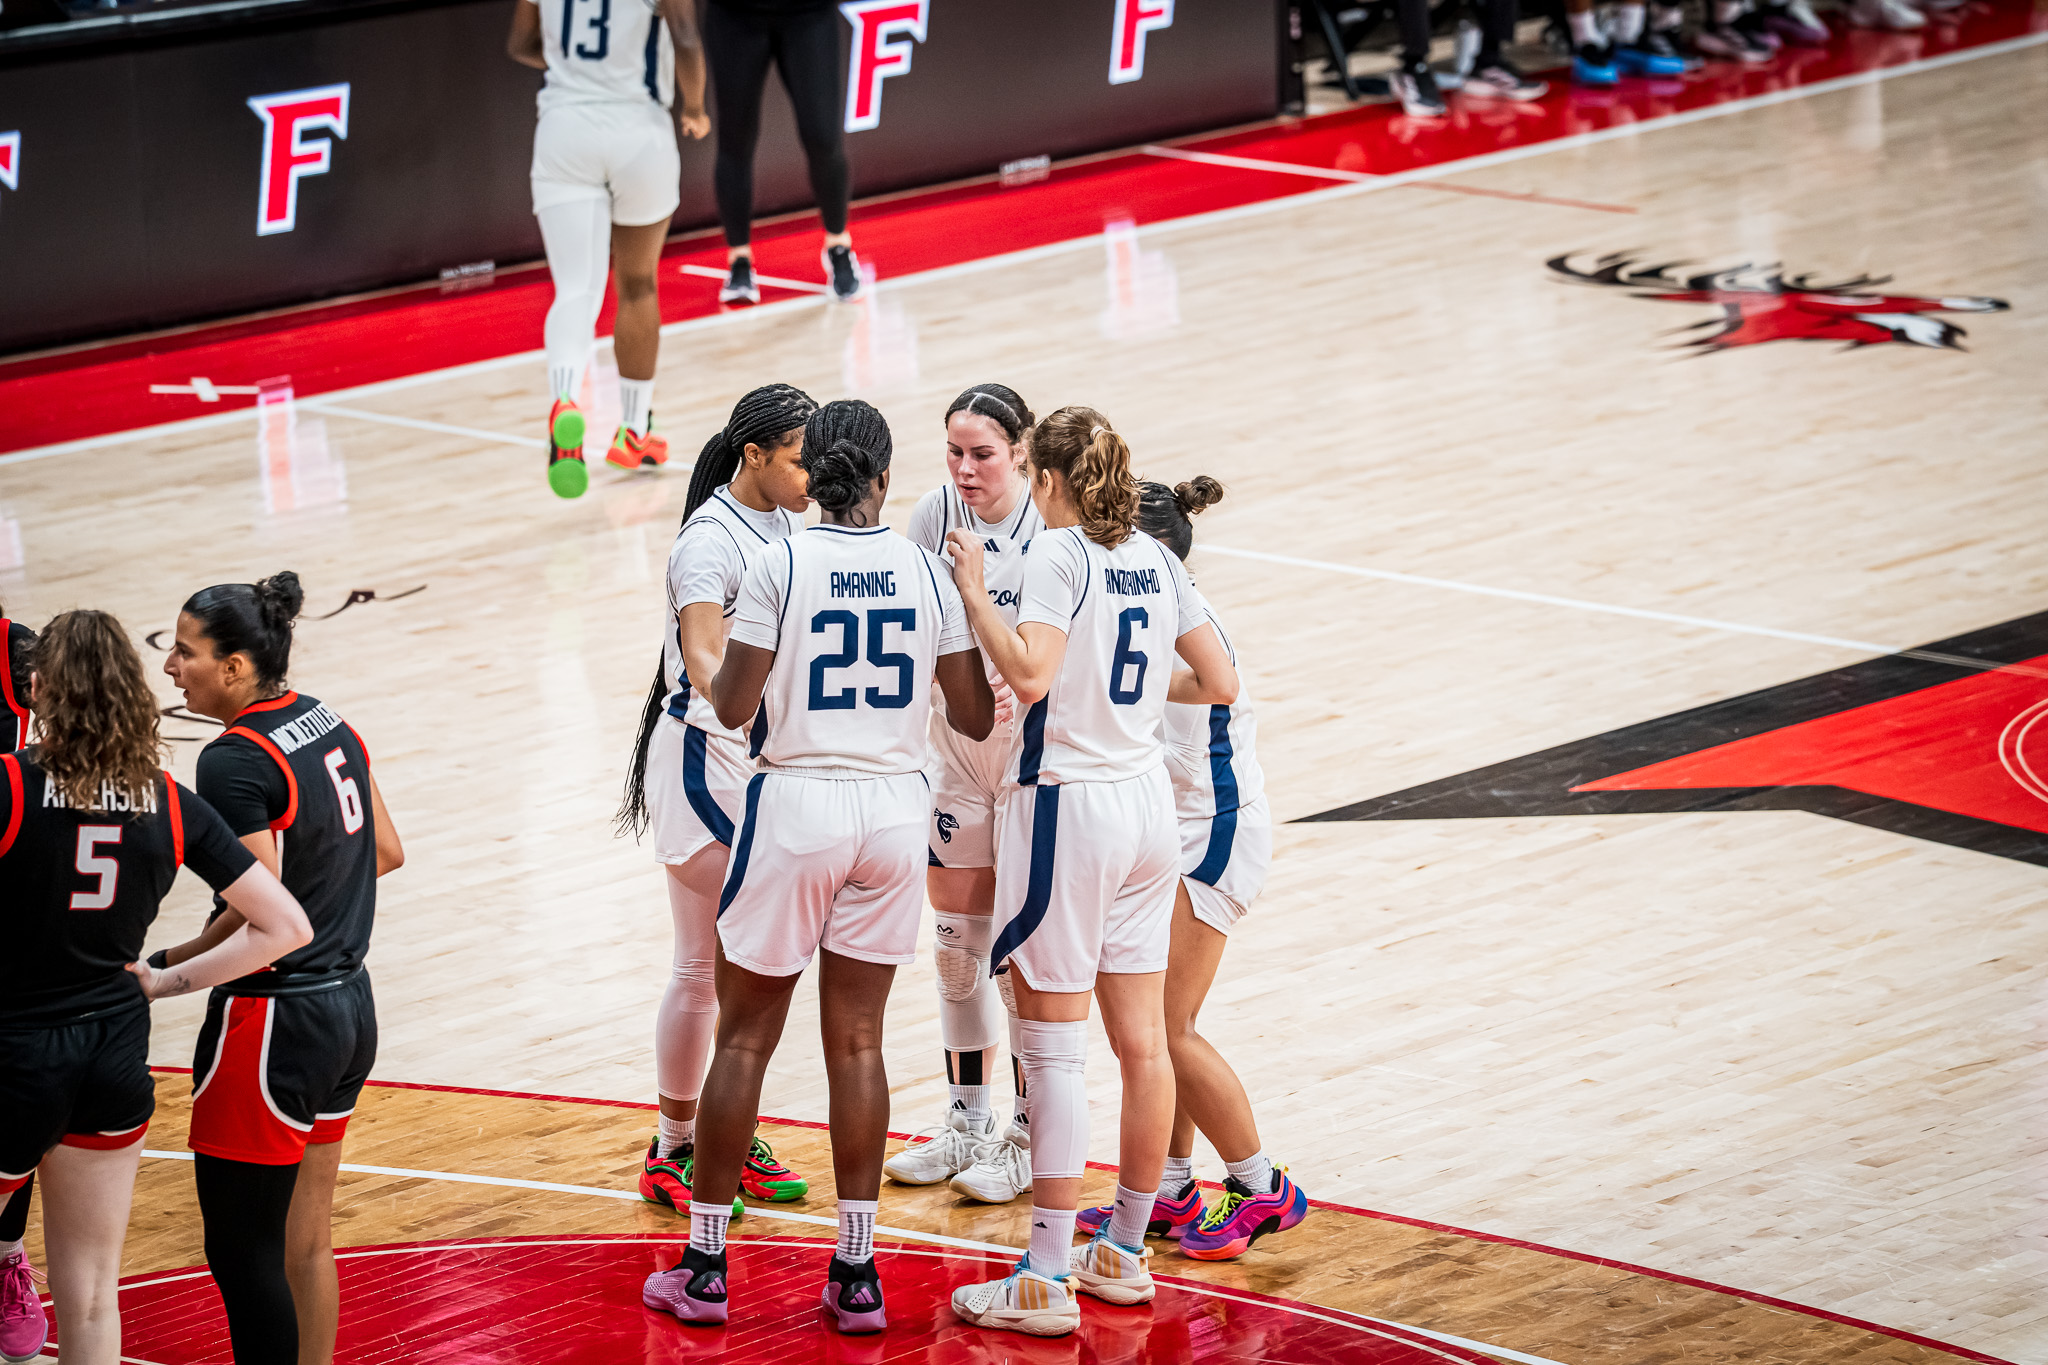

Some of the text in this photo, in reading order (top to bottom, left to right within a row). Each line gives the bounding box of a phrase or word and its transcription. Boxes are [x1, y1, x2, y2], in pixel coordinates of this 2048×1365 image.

[561, 0, 610, 61] 13
[838, 0, 930, 133] F
[248, 83, 350, 236] F
[831, 570, 897, 598] AMANING
[808, 608, 916, 711] 25
[1109, 606, 1148, 705] 6
[324, 746, 364, 836] 6
[69, 824, 123, 911] 5
